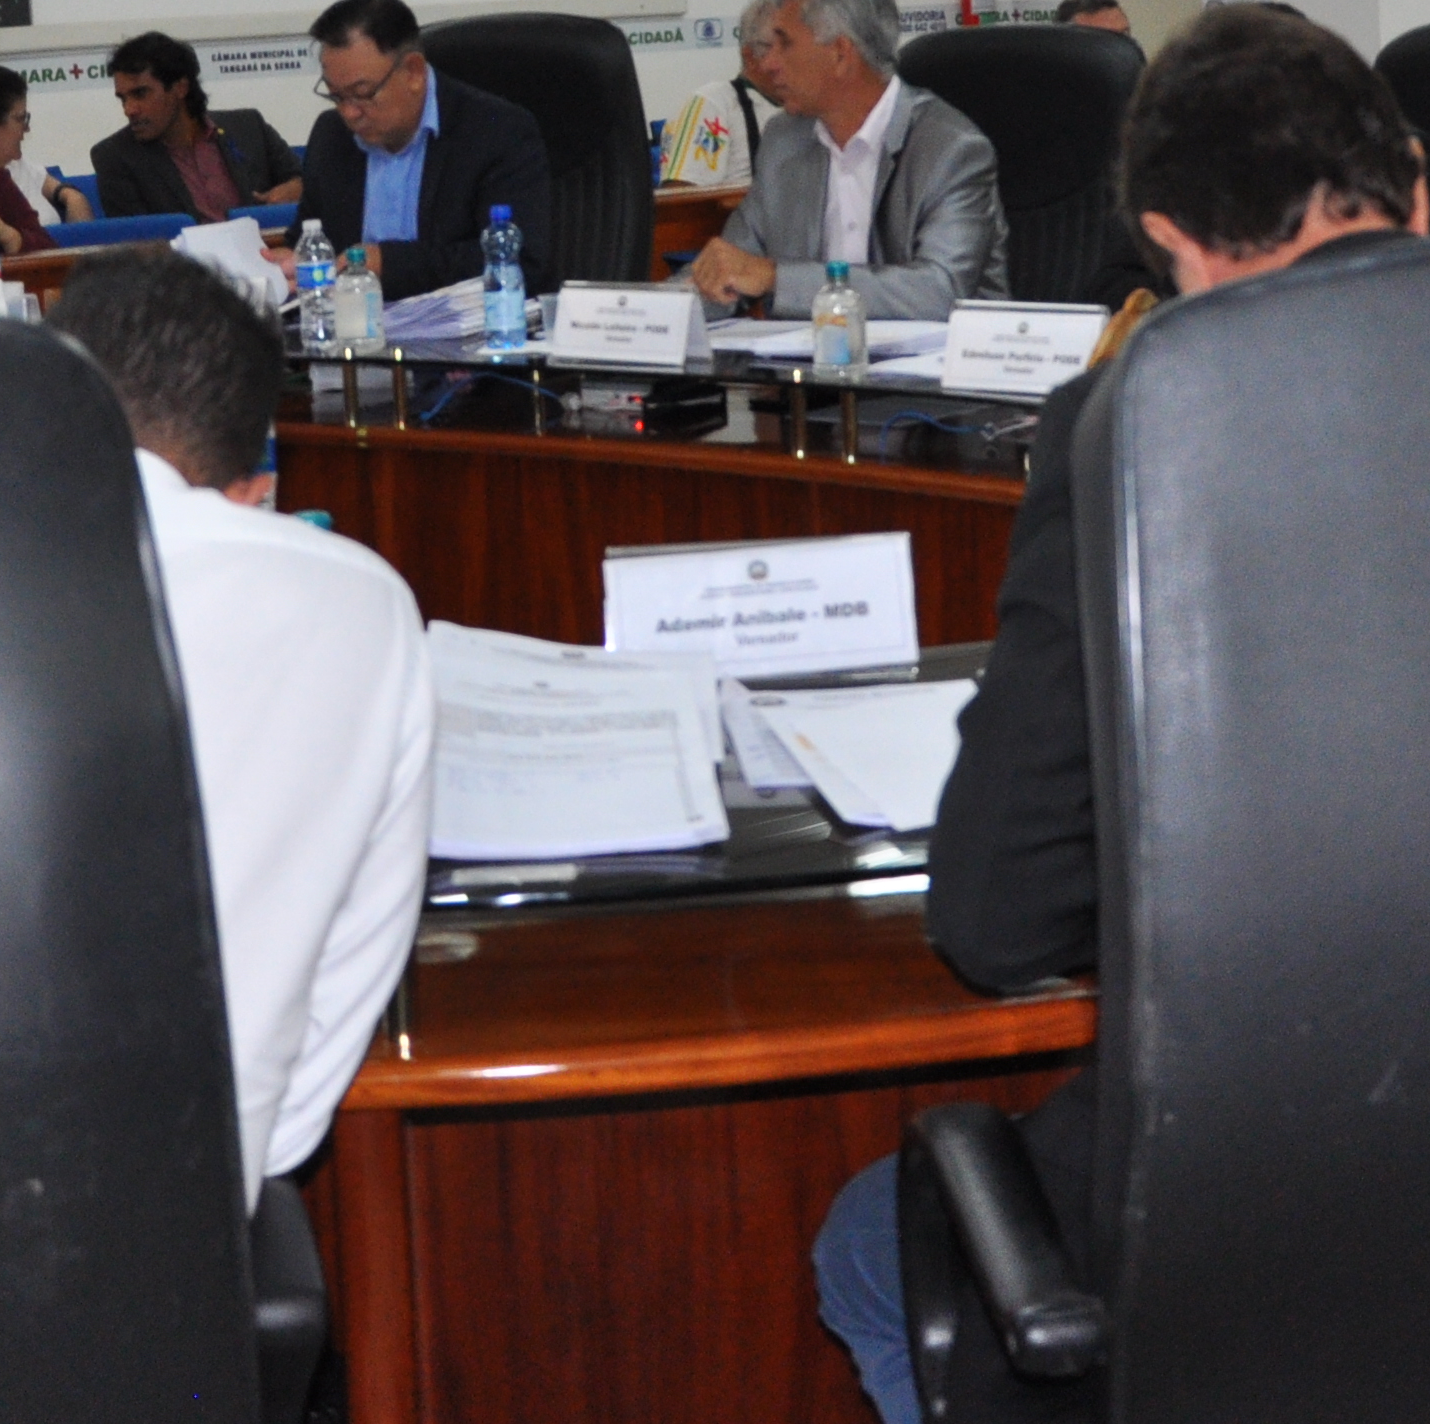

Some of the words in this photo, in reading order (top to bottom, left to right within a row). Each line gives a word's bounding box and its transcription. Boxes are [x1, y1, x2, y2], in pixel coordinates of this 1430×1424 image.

[628, 27, 684, 46] CIDADÃ
[211, 51, 248, 63] CÂMARA
[250, 49, 295, 60] MUNICIPAL
[260, 62, 272, 72] DA
[274, 61, 302, 71] SERRA
[656, 614, 726, 633] Ademir
[733, 605, 807, 627] Anibale
[824, 601, 870, 618] MDB
